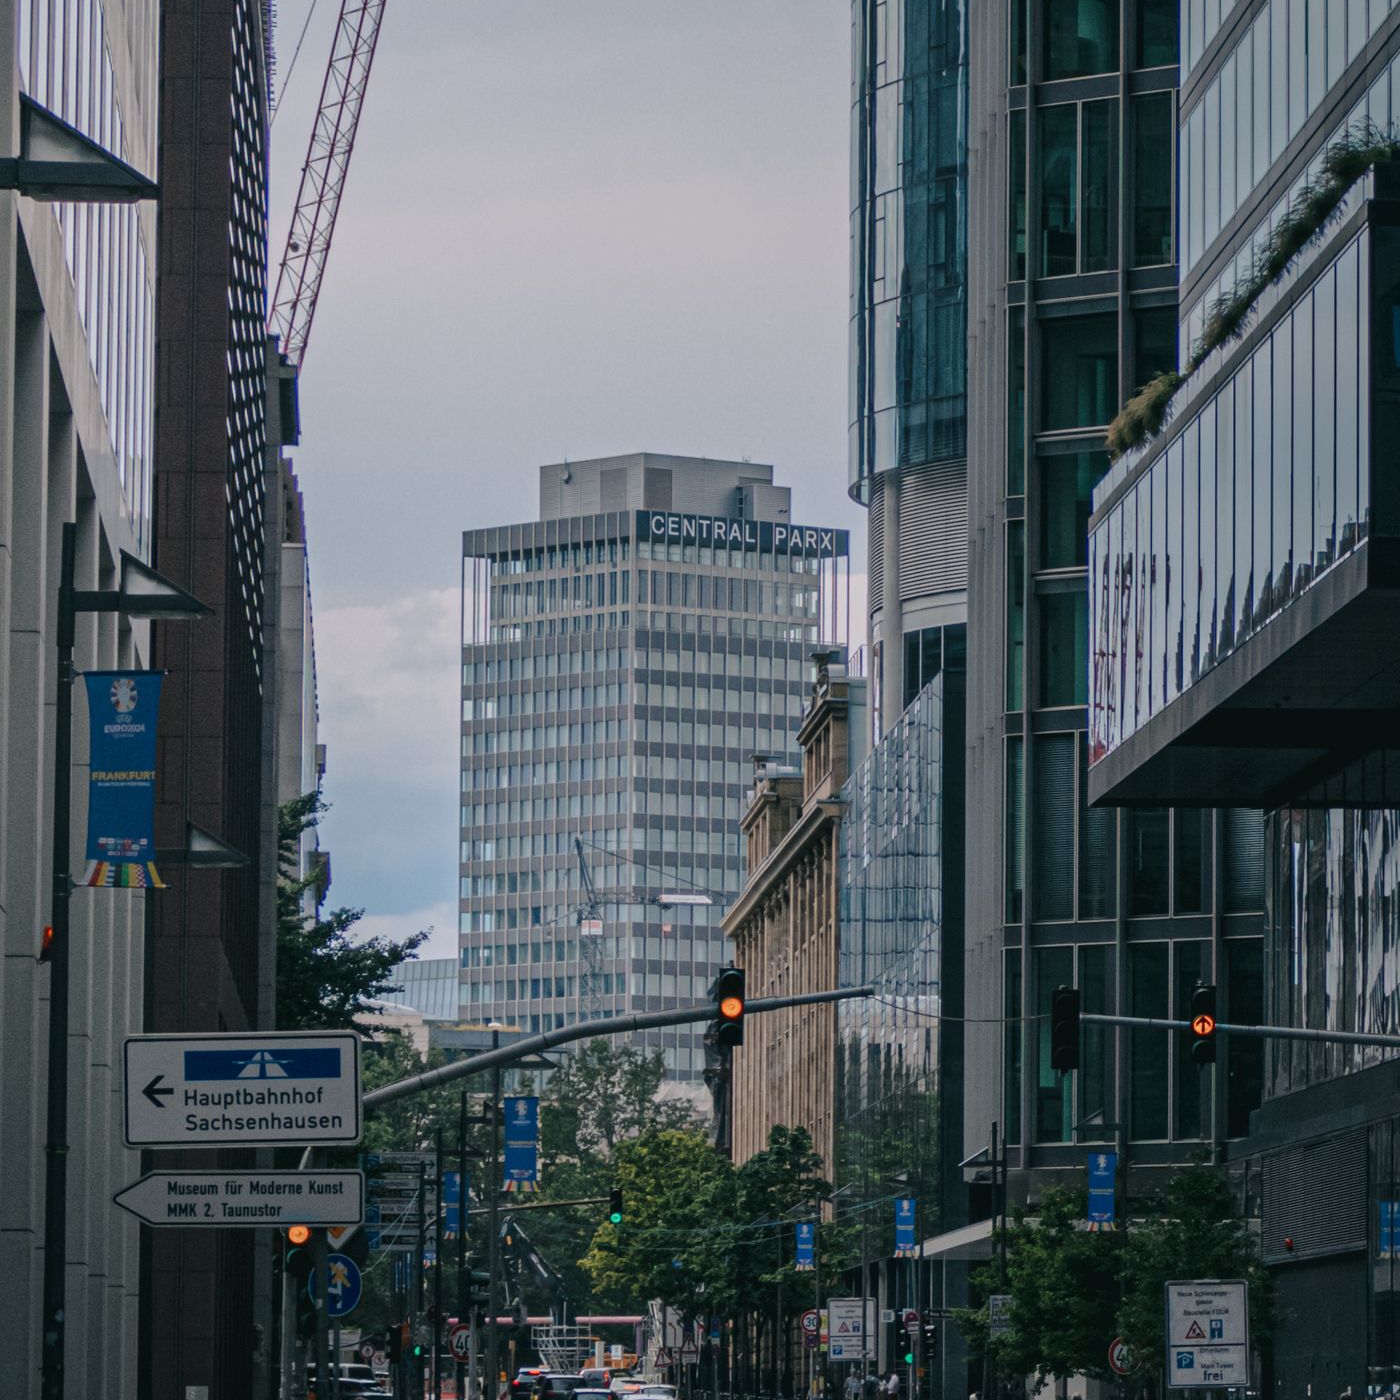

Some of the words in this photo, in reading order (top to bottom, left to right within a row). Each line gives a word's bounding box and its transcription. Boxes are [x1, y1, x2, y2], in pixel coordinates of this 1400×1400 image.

[651, 515, 756, 543] CENTRAL
[775, 527, 833, 550] PARX
[91, 771, 156, 781] FRANKFURT
[184, 1087, 323, 1109] Hauptbahnhof
[185, 1113, 342, 1131] Sachsenhausen
[167, 1181, 218, 1195] Museum
[225, 1181, 243, 1195] für
[249, 1180, 302, 1195] Moderne
[309, 1180, 344, 1195] Kunst
[167, 1203, 197, 1217] MMK
[221, 1202, 282, 1217] Taunustor
[1203, 1370, 1223, 1381] frei
